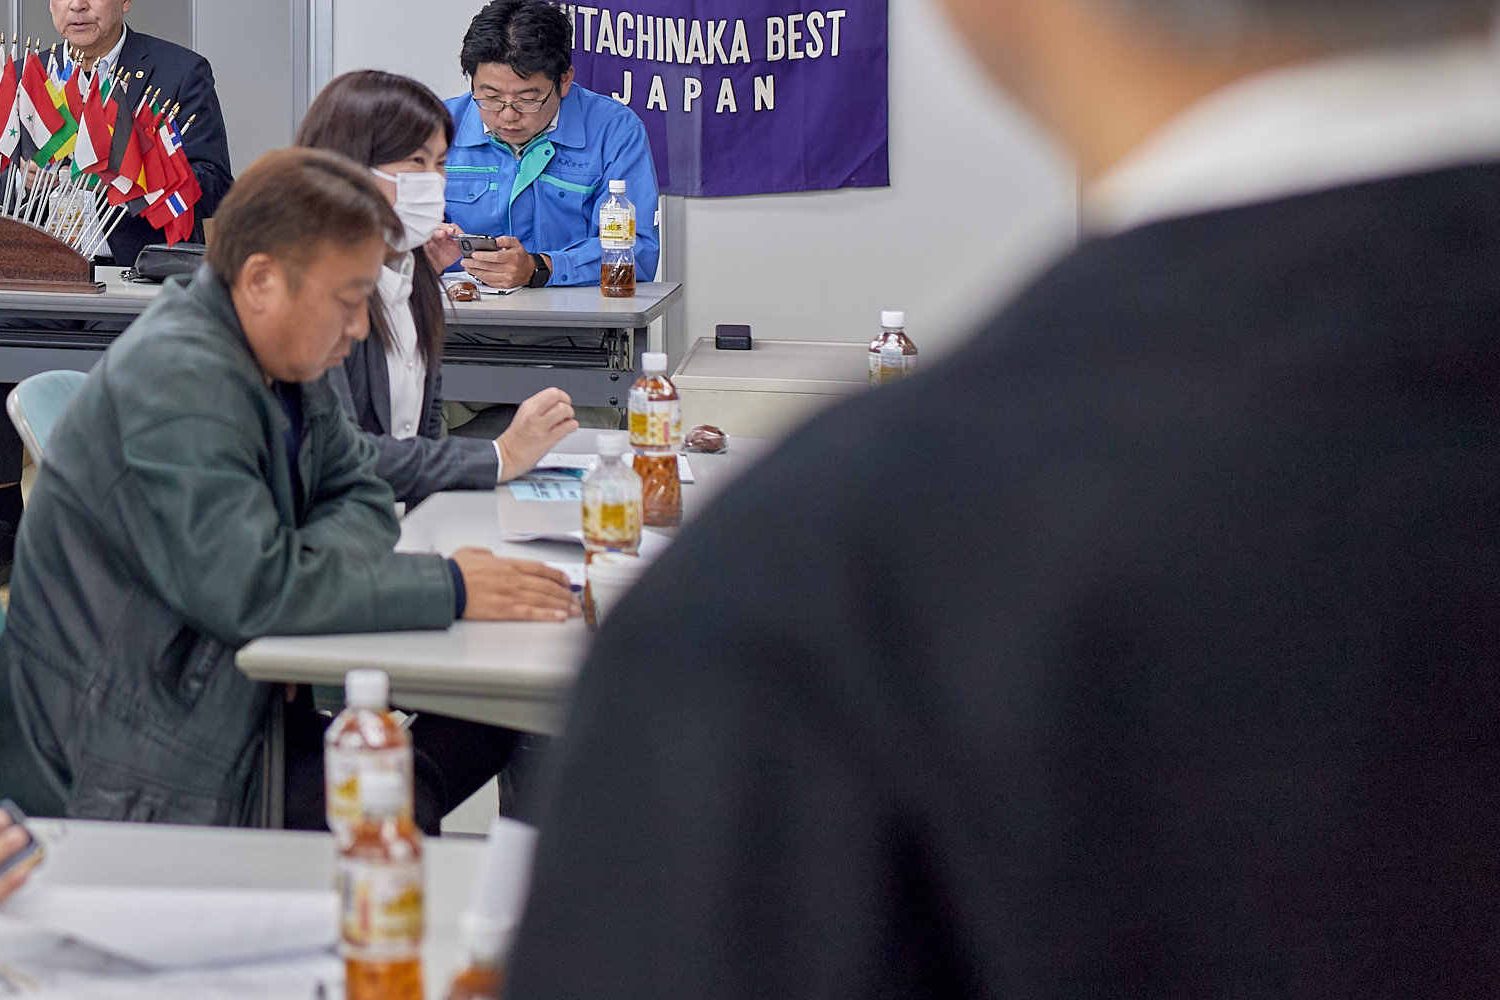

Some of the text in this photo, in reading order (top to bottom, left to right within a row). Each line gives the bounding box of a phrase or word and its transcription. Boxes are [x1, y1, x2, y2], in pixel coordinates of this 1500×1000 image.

[549, 2, 846, 64] ITACHINAKA BEST
[611, 71, 776, 114] JAPAN
